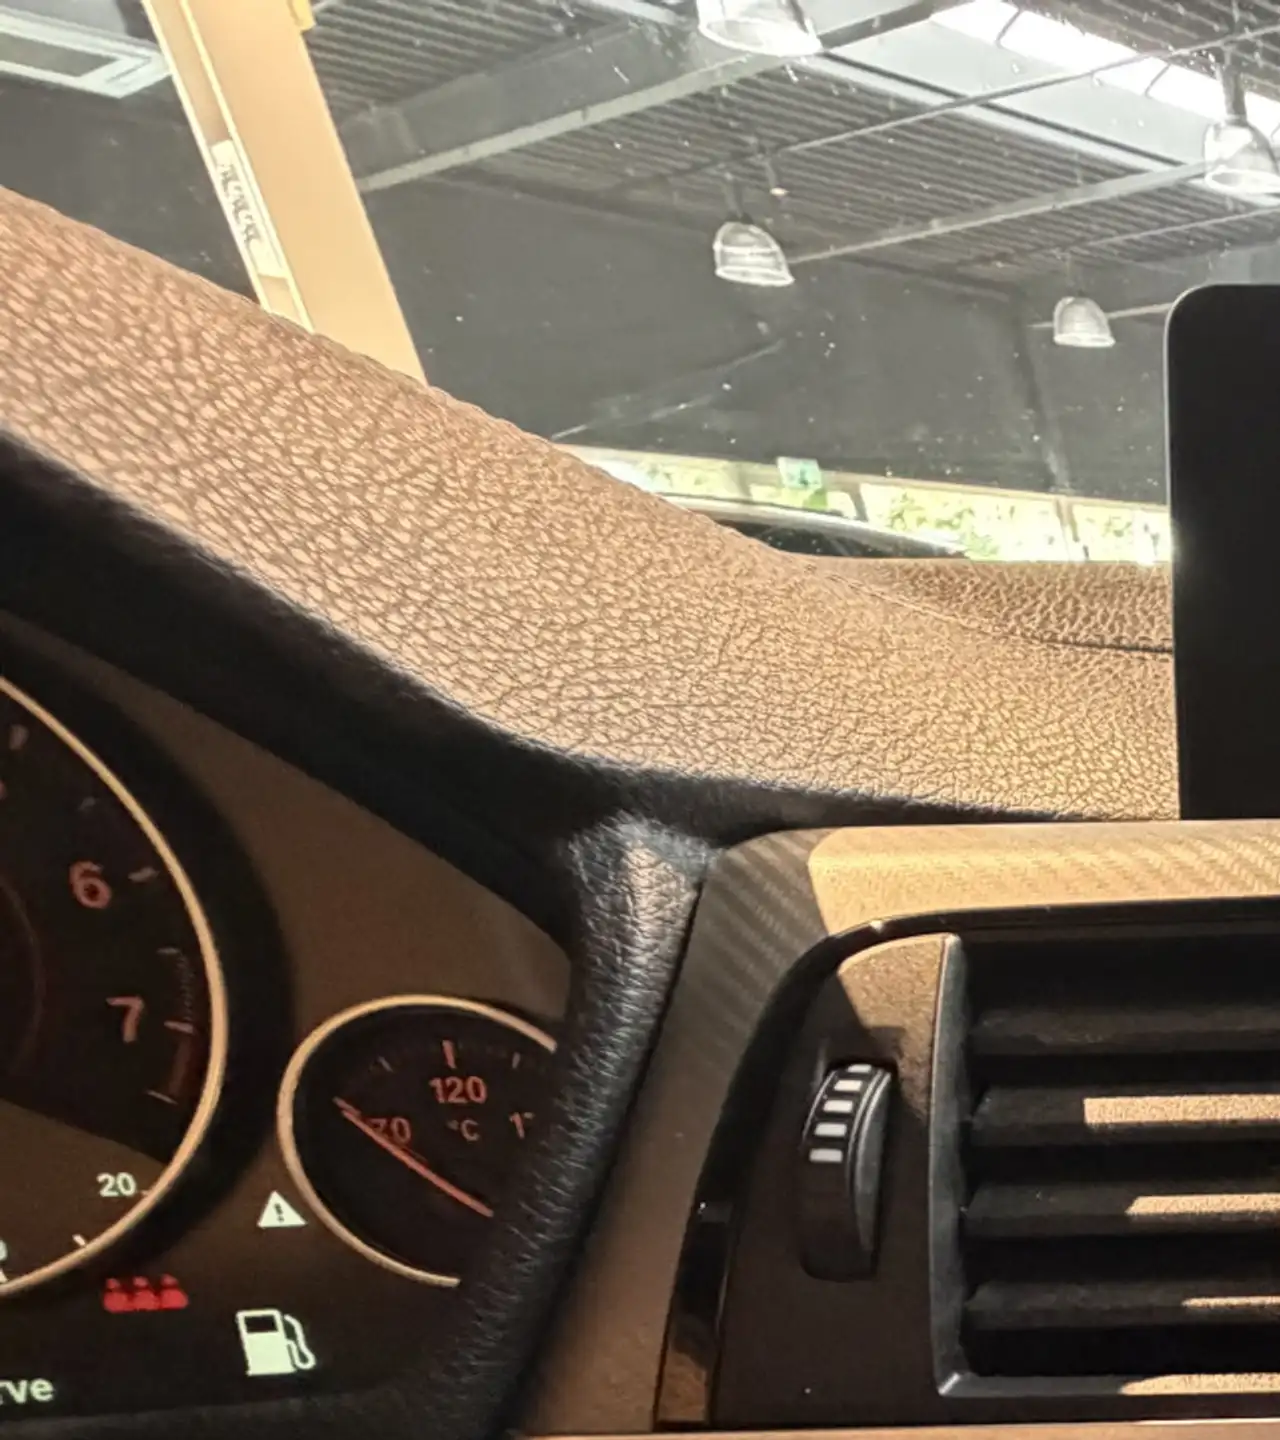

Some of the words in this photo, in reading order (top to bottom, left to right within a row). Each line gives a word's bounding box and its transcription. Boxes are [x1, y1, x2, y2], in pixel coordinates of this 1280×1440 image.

[69, 860, 112, 909] 6
[105, 996, 145, 1042] 7
[428, 1075, 488, 1105] 120
[97, 1172, 136, 1197] 20
